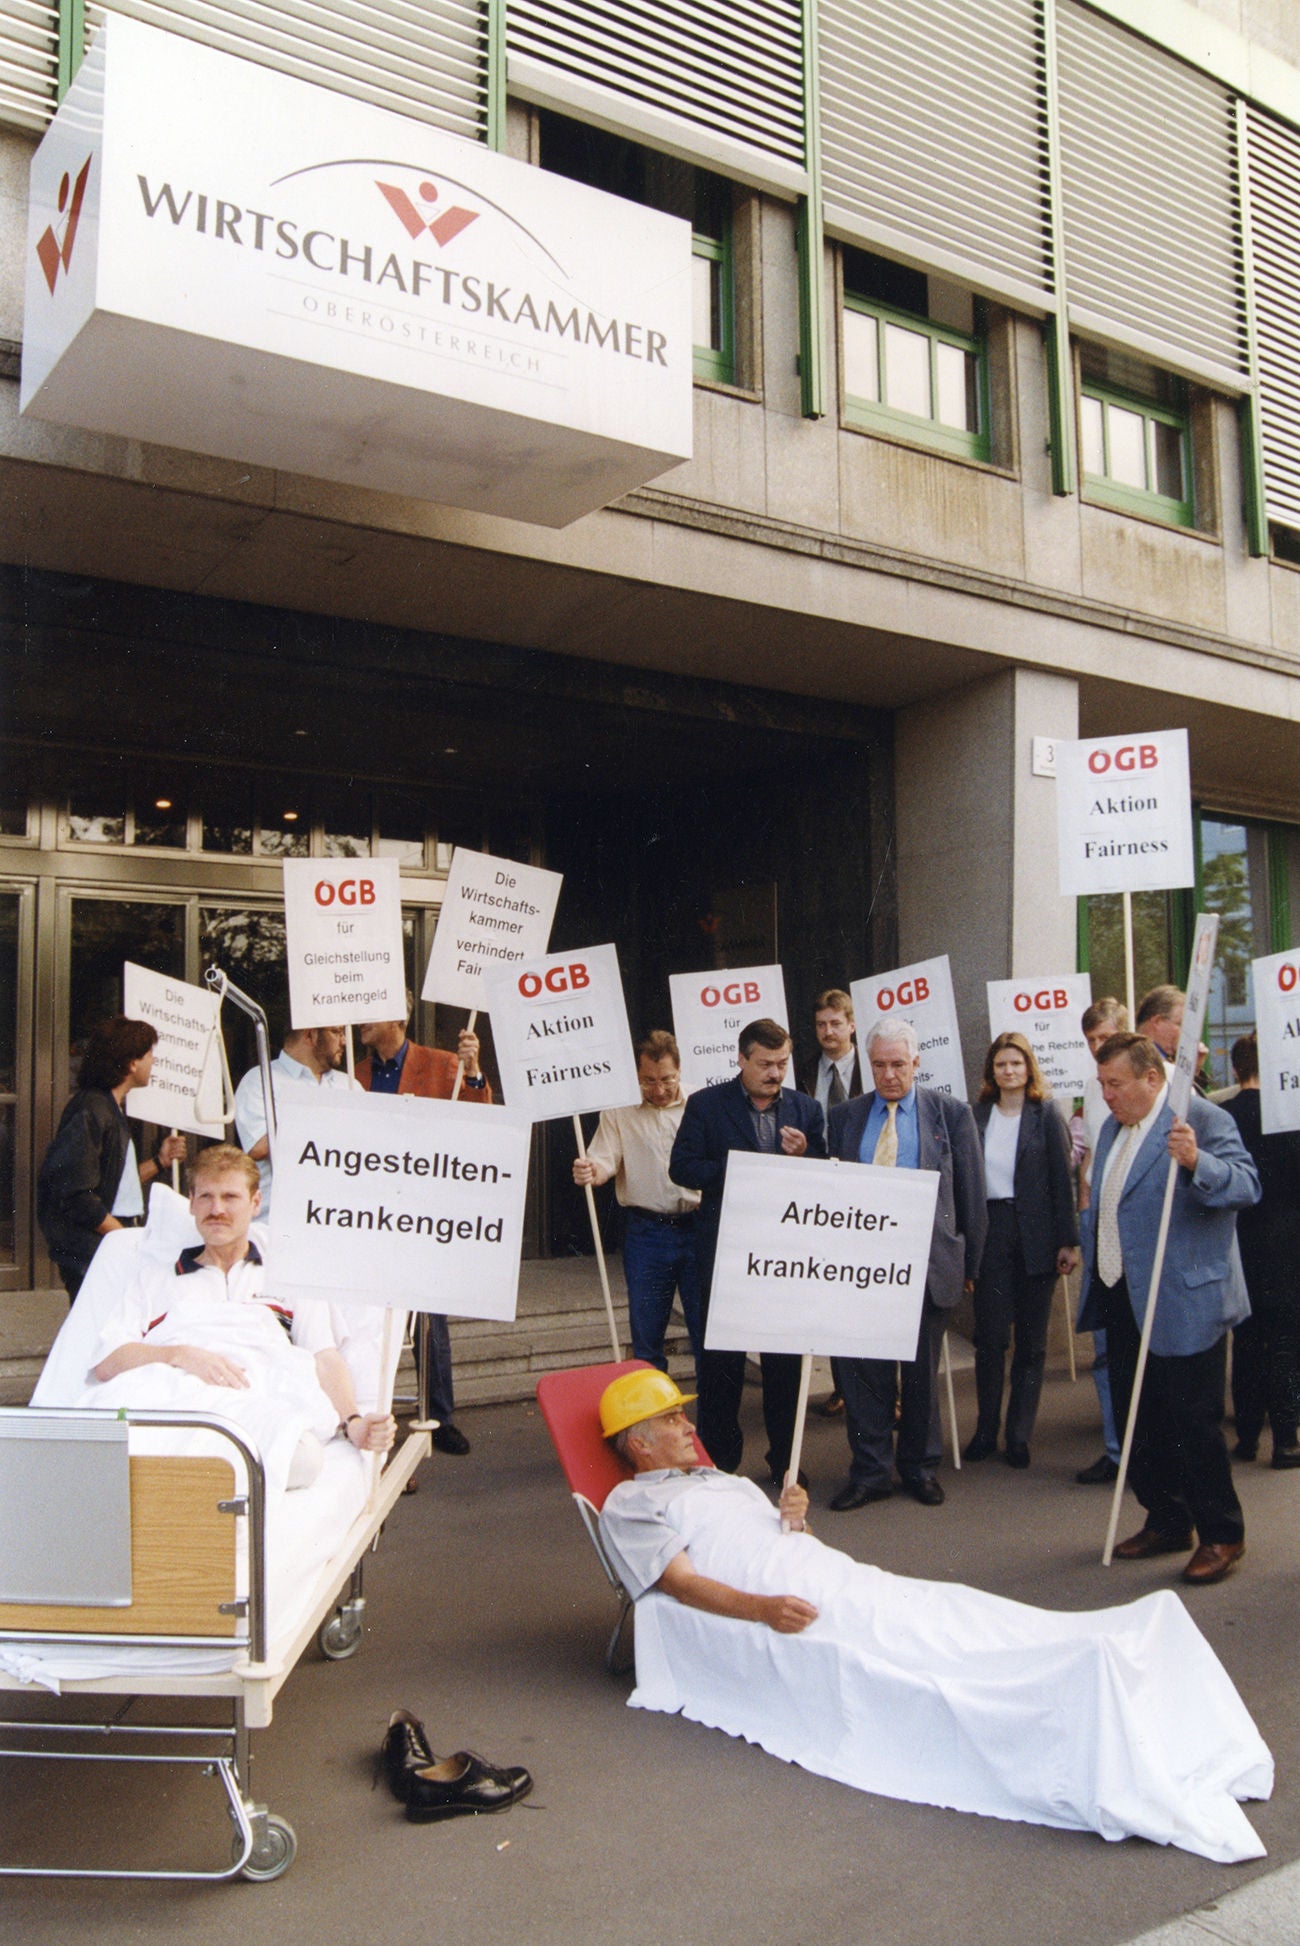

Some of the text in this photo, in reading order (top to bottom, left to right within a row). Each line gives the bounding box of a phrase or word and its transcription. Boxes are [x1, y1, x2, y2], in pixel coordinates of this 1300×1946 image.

[136, 174, 669, 367] WIRTSCHAFTSKAMMER
[1089, 796, 1158, 816] Aktion
[1084, 838, 1169, 859] Fairness
[495, 871, 516, 889] Die
[461, 885, 541, 917] Wirtschafts-
[337, 921, 354, 934] für
[469, 910, 524, 934] kammer
[303, 949, 390, 966] Gleichstellung
[456, 939, 524, 962] verhindert
[334, 971, 364, 984] beim
[456, 959, 482, 976] Fair
[165, 989, 184, 1006] Die
[312, 989, 387, 1007] Krankengeld
[139, 1000, 210, 1033] Wirtschafts-
[724, 1018, 740, 1029] für
[526, 1015, 594, 1040] Aktion
[1034, 1023, 1050, 1032] für
[158, 1031, 199, 1051] ammer
[693, 1043, 736, 1056] Gleiche
[1048, 1040, 1085, 1051] Rechte
[154, 1056, 203, 1078] erhinder
[1038, 1056, 1054, 1064] bei
[526, 1060, 612, 1087] Fairness
[1044, 1067, 1068, 1076] eits-
[150, 1075, 198, 1097] Fairnes
[298, 1140, 512, 1184] Angestellten-
[306, 1199, 504, 1244] krankengeld
[781, 1201, 898, 1231] Arbeiter-
[747, 1252, 912, 1289] krankengeld
